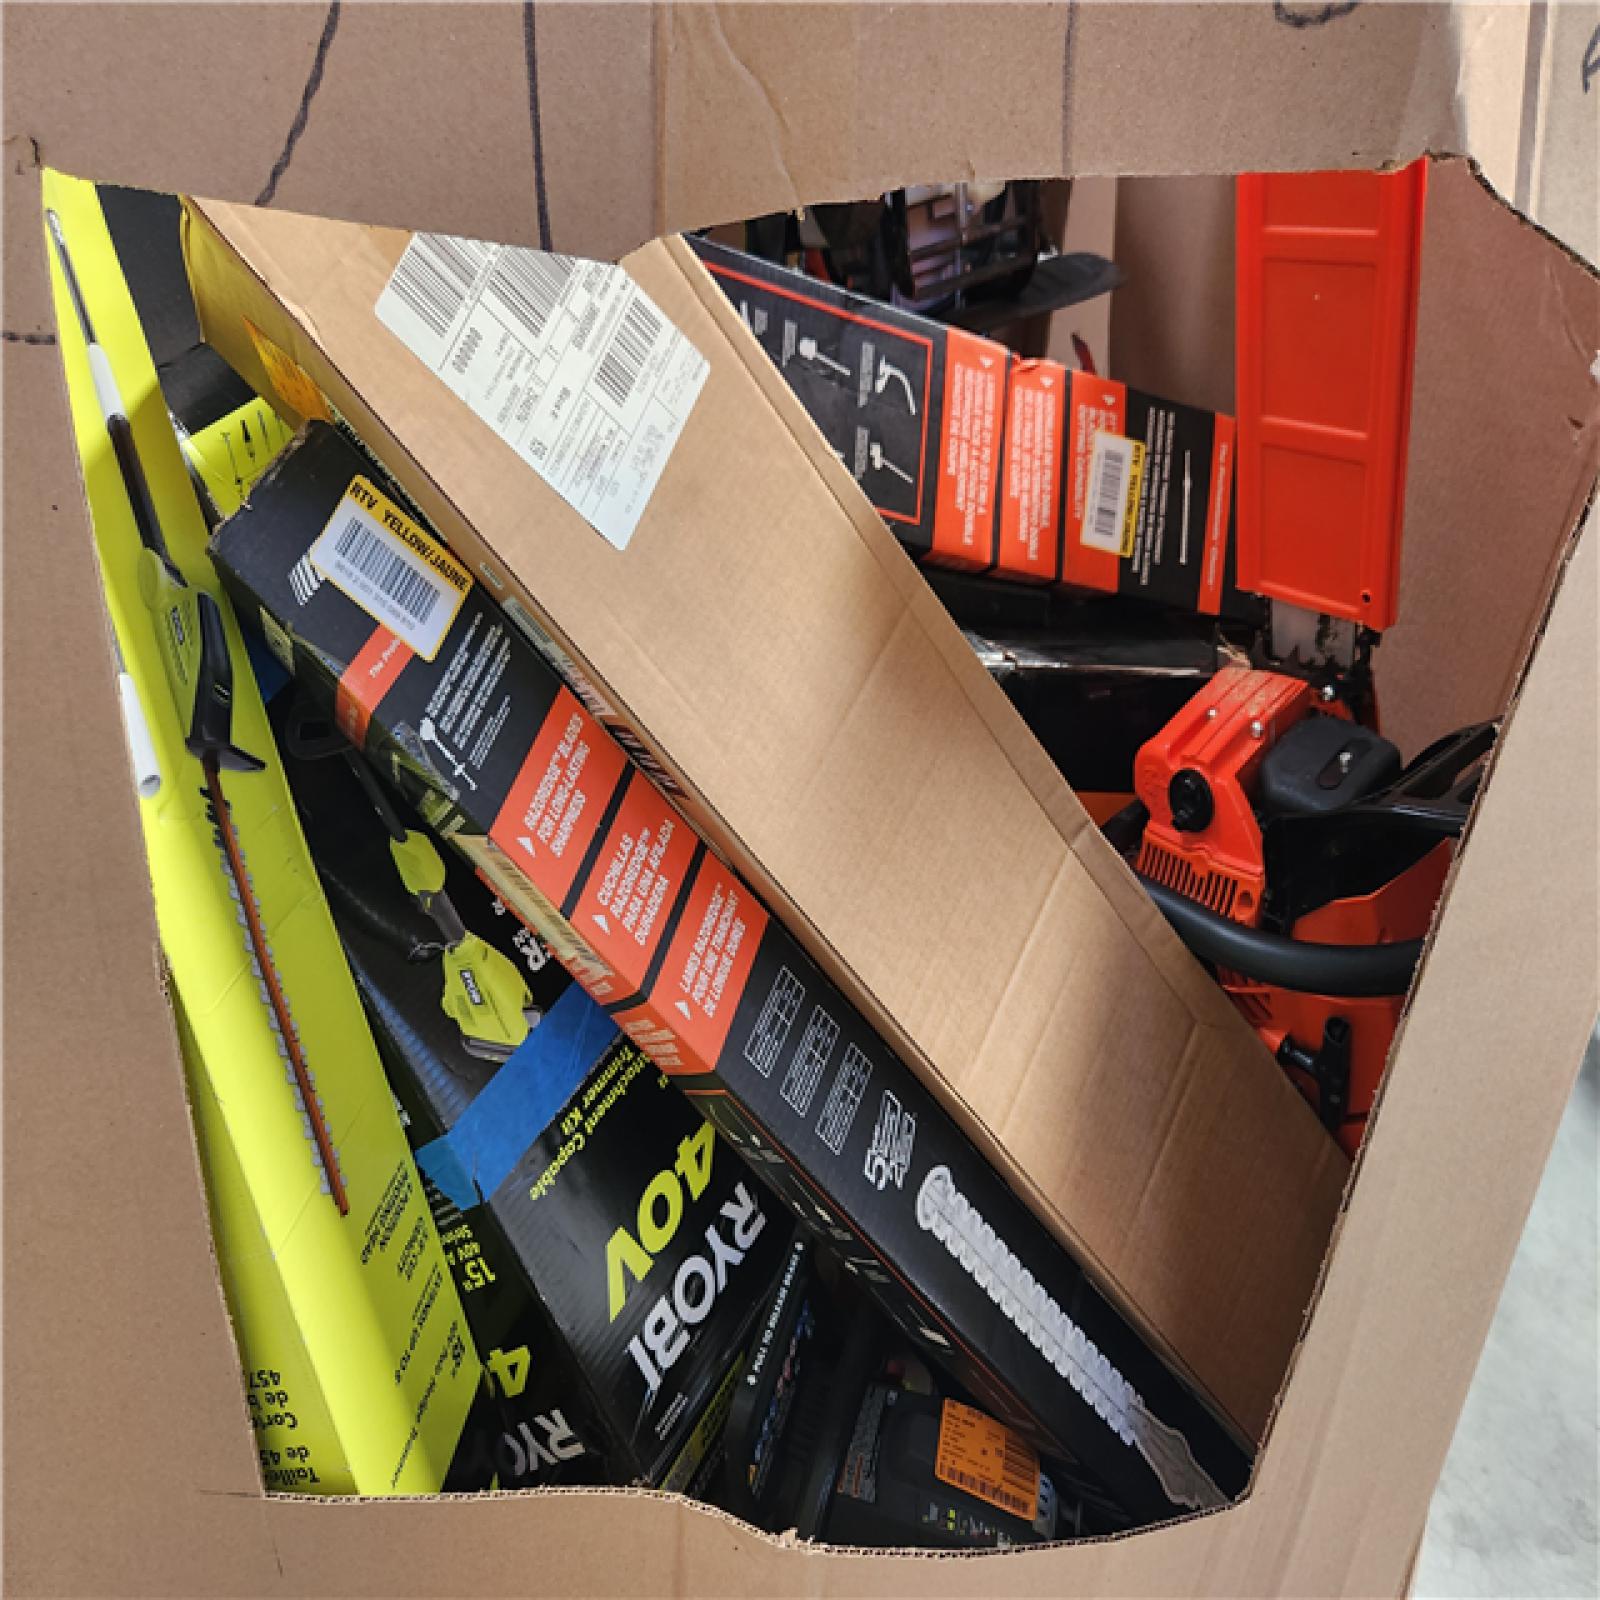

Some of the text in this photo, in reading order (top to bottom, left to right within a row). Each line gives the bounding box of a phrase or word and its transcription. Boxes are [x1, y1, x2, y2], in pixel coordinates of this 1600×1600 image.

[347, 482, 379, 510] RTV
[381, 508, 469, 592] YELLOW/JAUNE
[557, 712, 584, 758] BLADES
[536, 739, 589, 843] FOR LONG-LASTING
[550, 788, 586, 857] SHARPNESS
[596, 832, 633, 906] CUCHILLAS
[621, 818, 675, 932] PARA UNA AFILADA
[634, 873, 669, 945] DURADERA
[679, 951, 701, 993] LAMES
[690, 889, 740, 1004] POUR UNE TRANCHANT
[709, 953, 733, 1000] LONGUE
[703, 997, 716, 1017] DE
[579, 1044, 634, 1111] Trimmer
[558, 1106, 584, 1139] Kit
[528, 1131, 586, 1202] Capable
[607, 1122, 716, 1322] 40V
[416, 1271, 443, 1330] EXTENDS
[626, 1182, 767, 1394] RYOBI
[397, 1349, 411, 1372] TO
[407, 1327, 420, 1351] UP
[751, 1346, 767, 1373] PULL
[761, 1329, 773, 1344] TO
[767, 1285, 788, 1328] RELEASE
[264, 1389, 289, 1409] de
[413, 1376, 436, 1424] Hedge
[478, 1340, 531, 1401] 4
[285, 1444, 310, 1464] de
[390, 1425, 419, 1489] Trimmer
